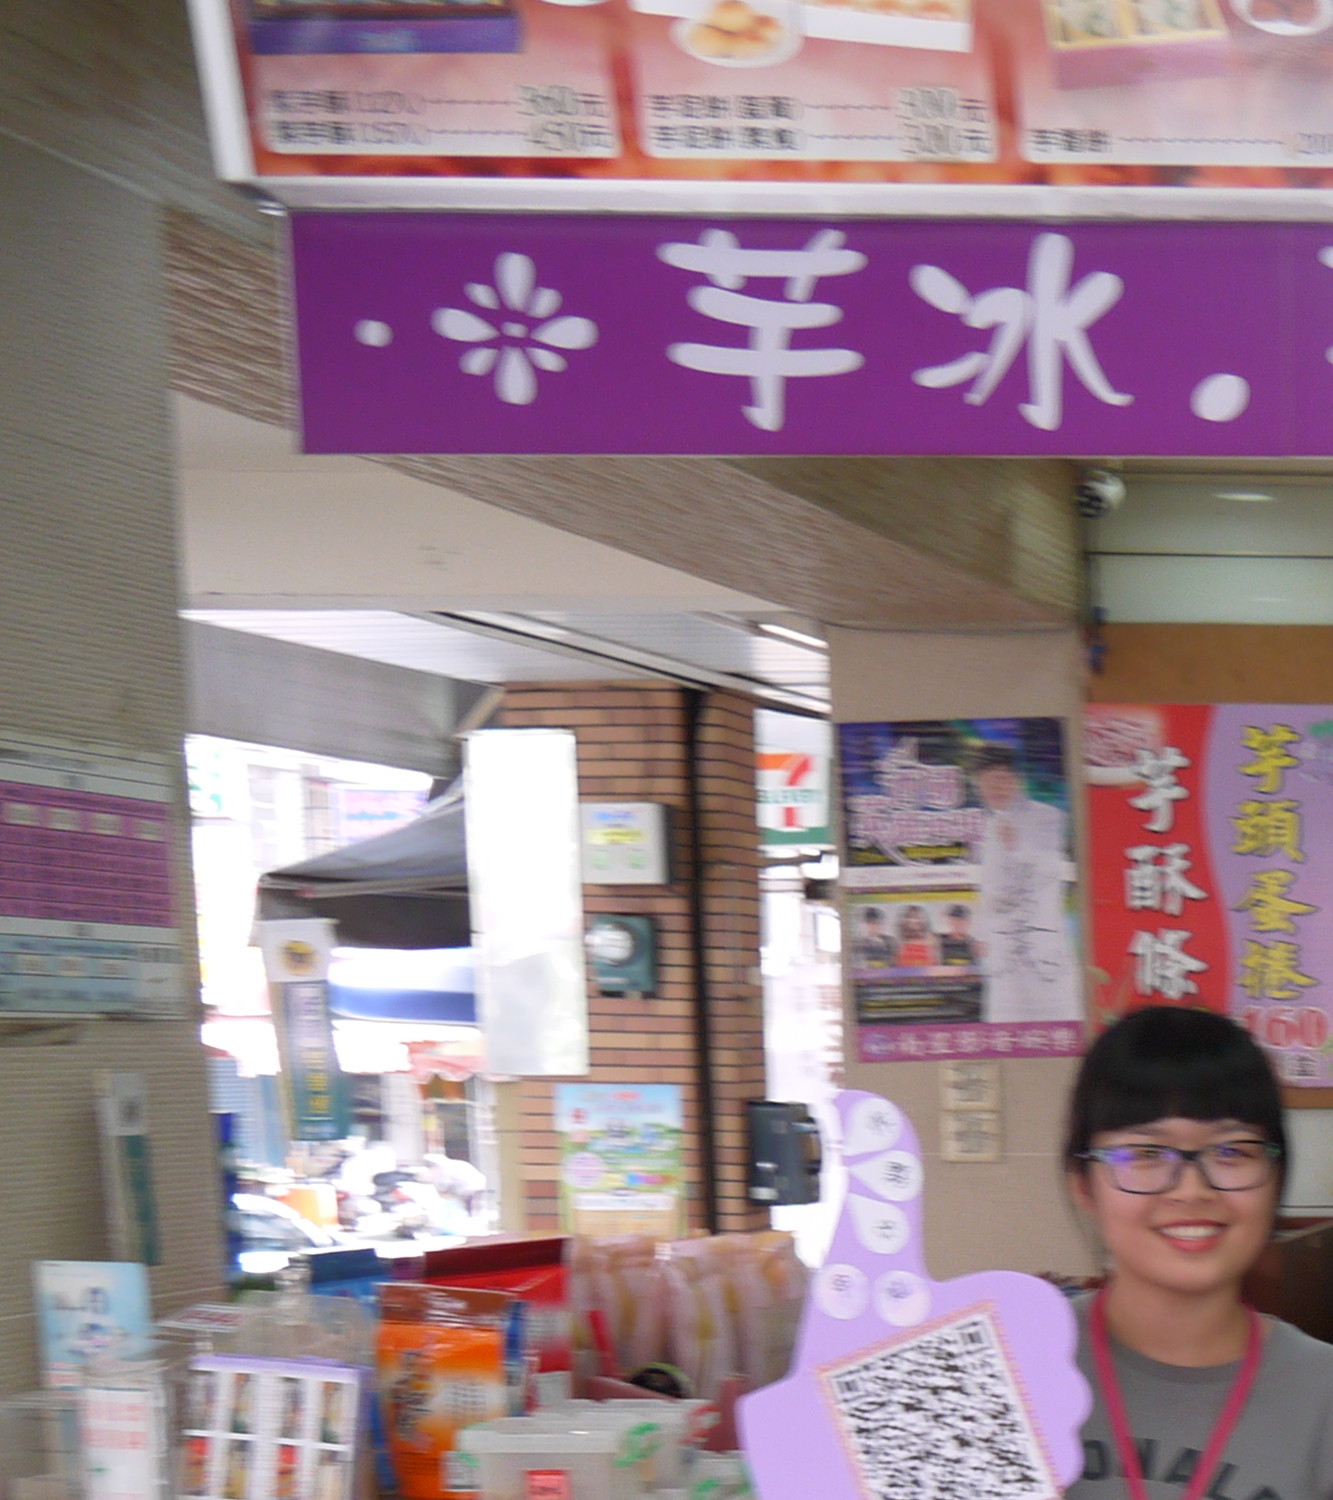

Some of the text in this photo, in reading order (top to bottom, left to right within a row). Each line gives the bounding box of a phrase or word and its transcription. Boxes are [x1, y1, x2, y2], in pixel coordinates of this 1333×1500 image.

[1123, 745, 1210, 1000] 芋酥條
[1230, 722, 1322, 1000] 芋頭蛋捲
[1236, 1004, 1331, 1052] 160
